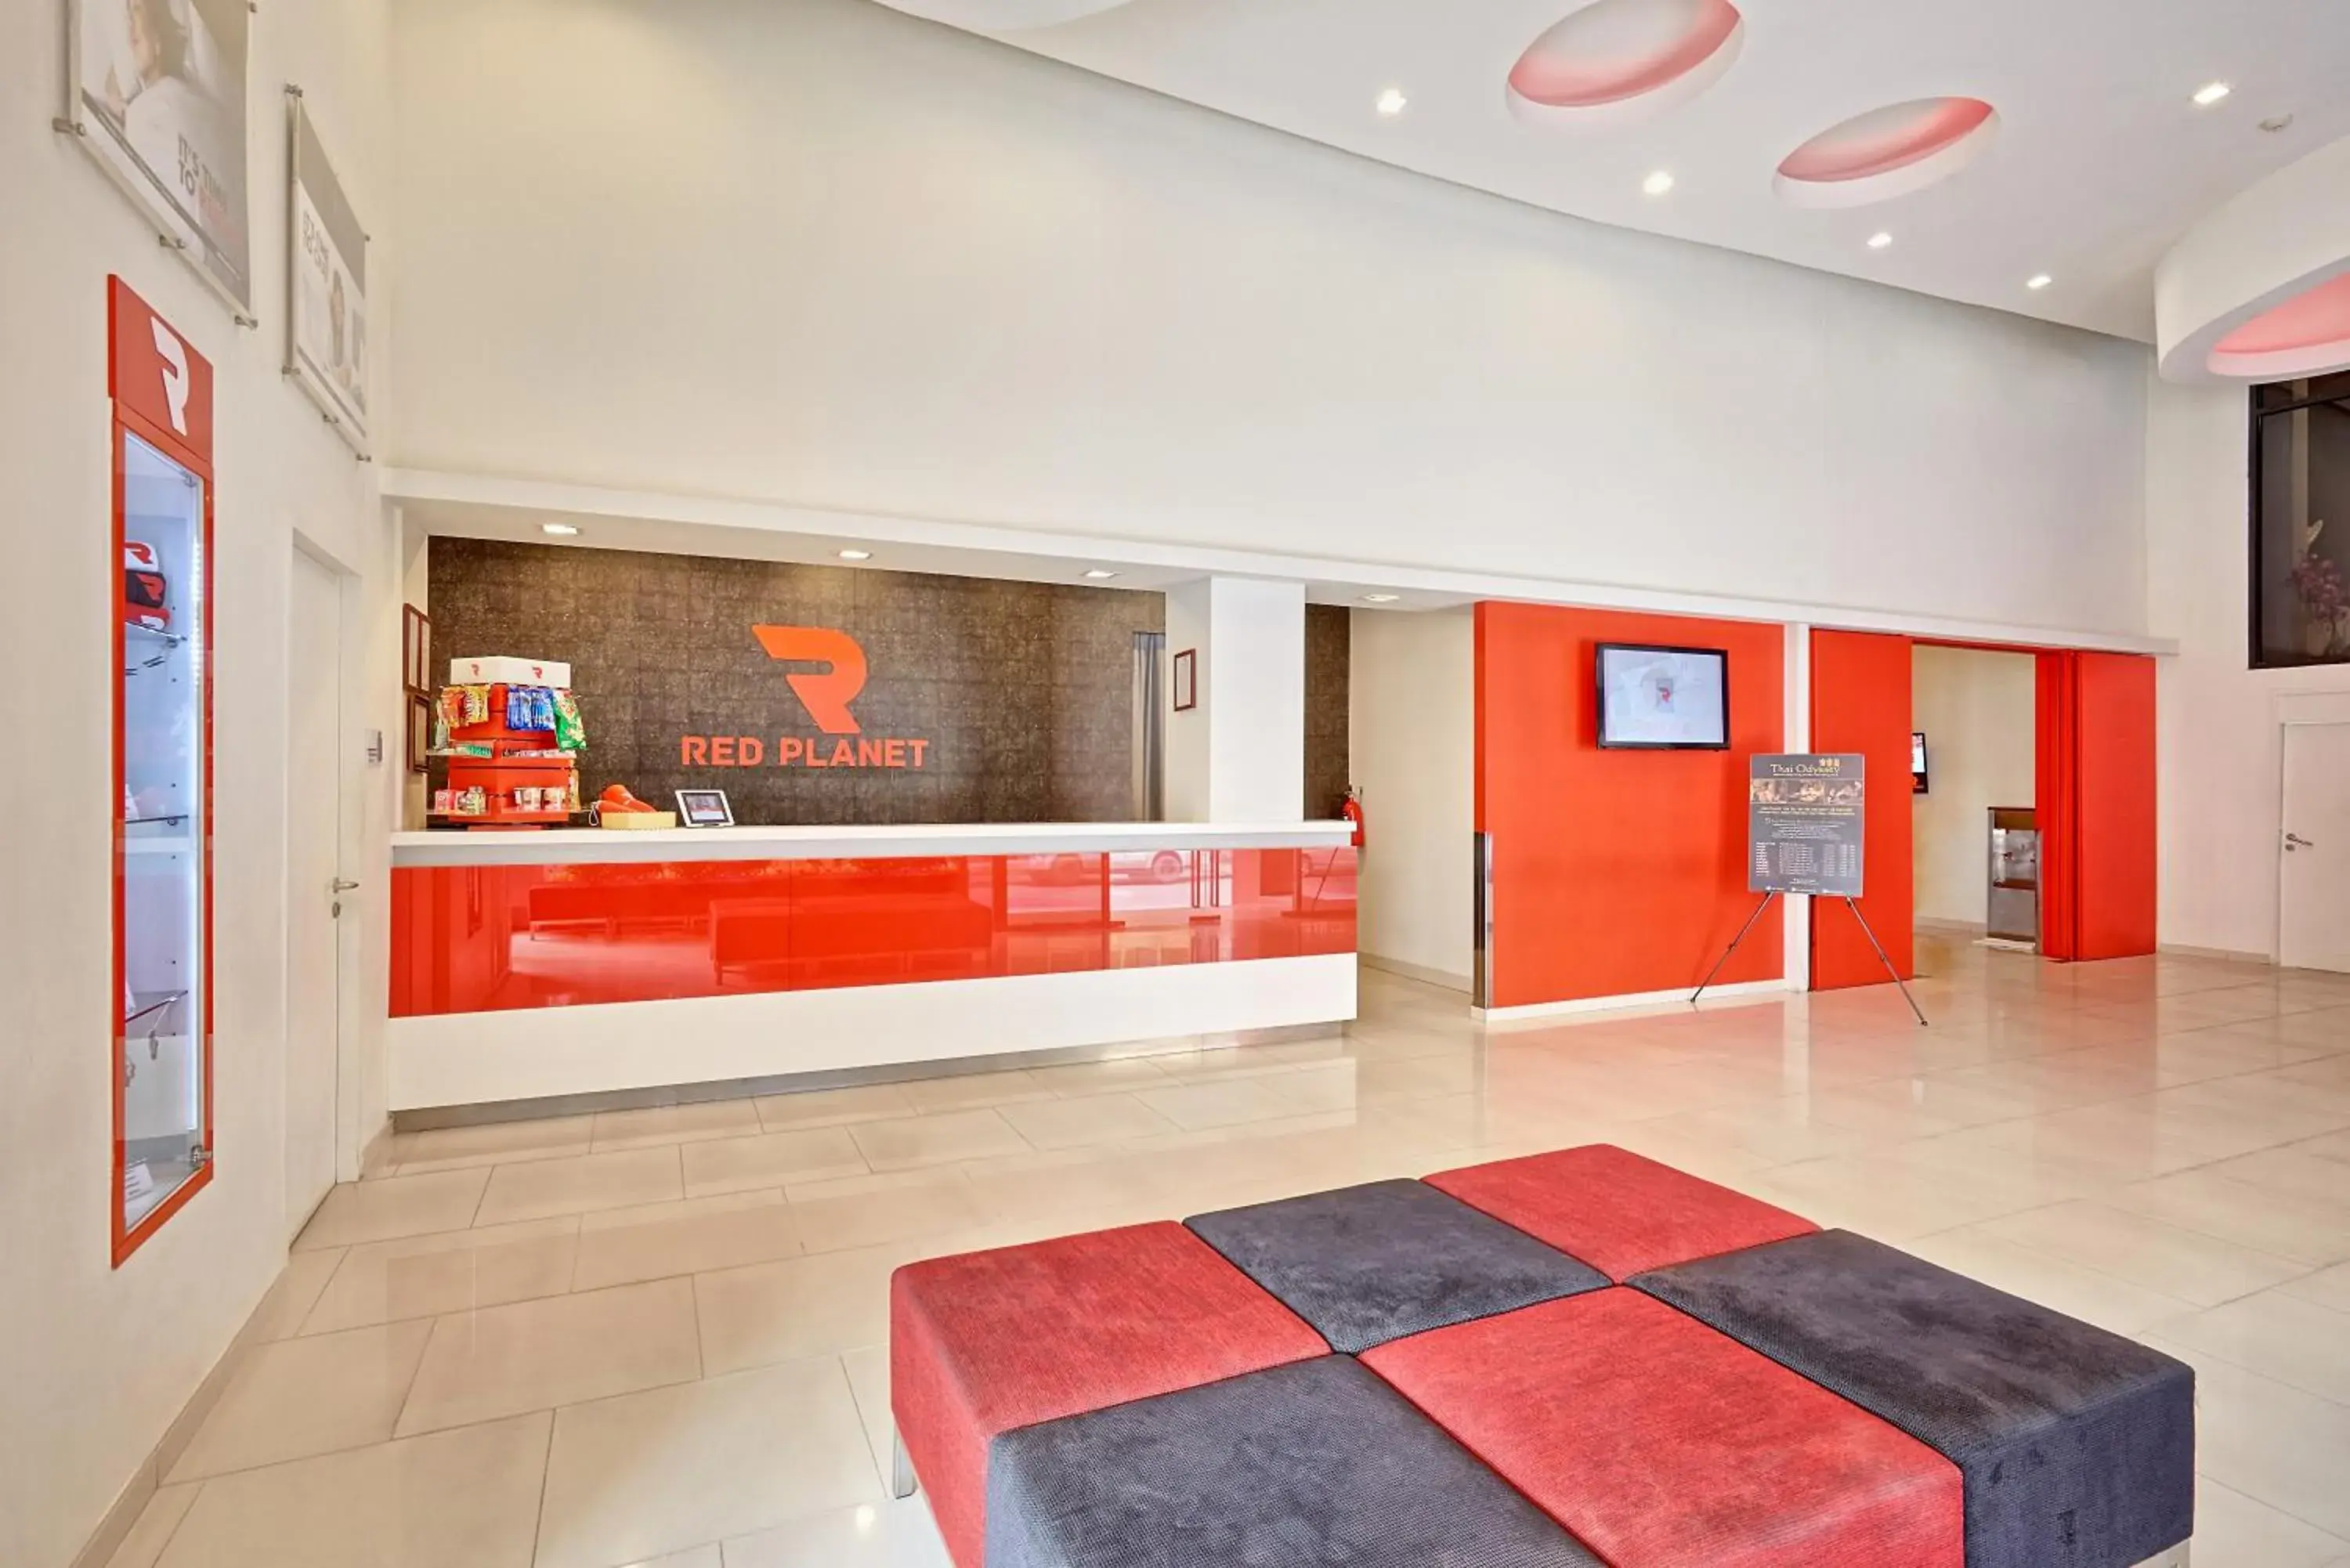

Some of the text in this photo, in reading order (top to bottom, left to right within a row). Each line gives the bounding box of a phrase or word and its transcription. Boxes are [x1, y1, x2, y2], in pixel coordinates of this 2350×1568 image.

[178, 159, 196, 196] TO
[681, 736, 929, 768] RED PLANET
[1770, 764, 1794, 773] Thai
